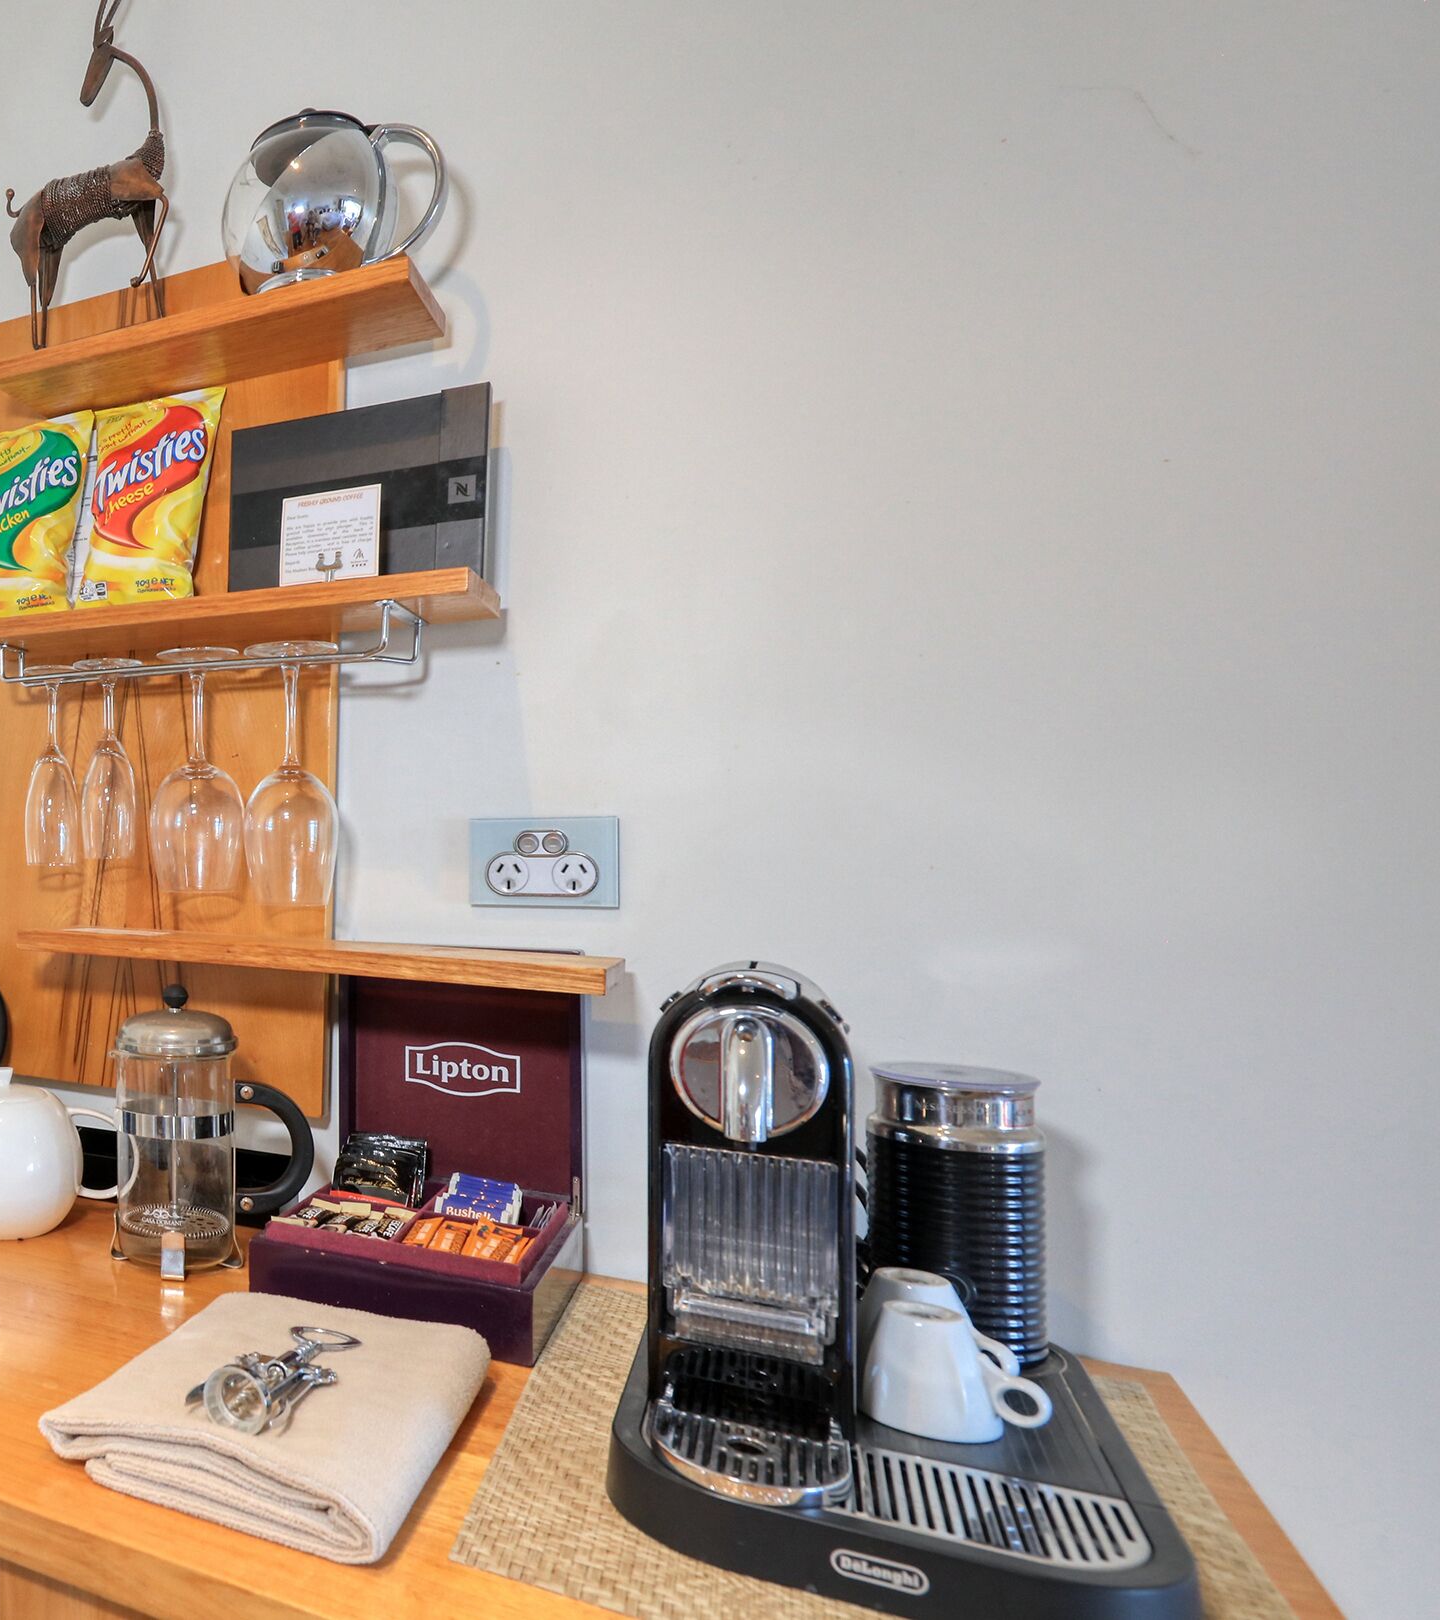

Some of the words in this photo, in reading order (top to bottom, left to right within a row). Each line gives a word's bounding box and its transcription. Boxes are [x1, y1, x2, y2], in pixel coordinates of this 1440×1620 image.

[95, 428, 206, 513] Twisties
[416, 1053, 510, 1083] Lipton
[840, 1555, 920, 1588] DeLonghi
